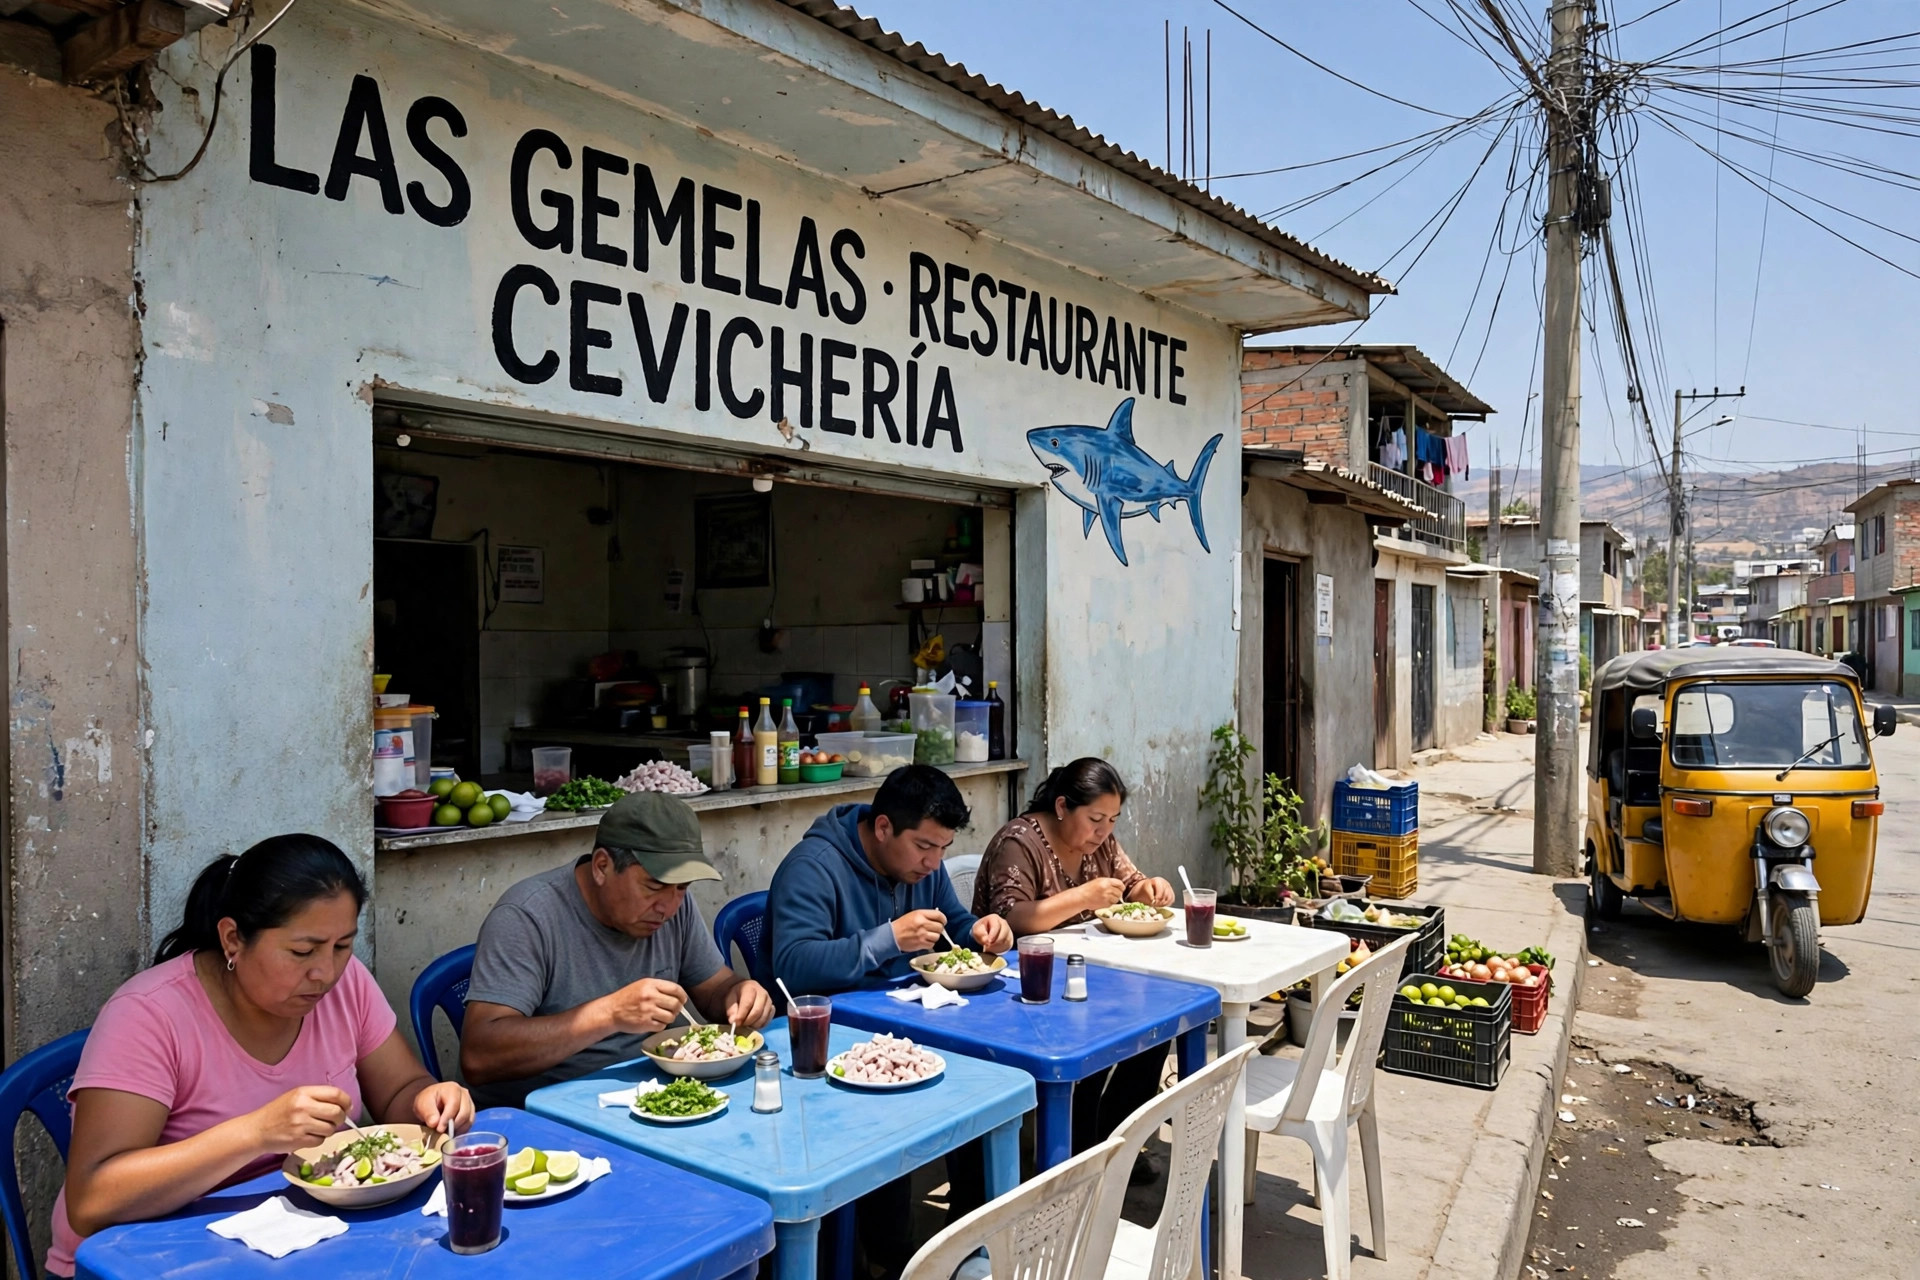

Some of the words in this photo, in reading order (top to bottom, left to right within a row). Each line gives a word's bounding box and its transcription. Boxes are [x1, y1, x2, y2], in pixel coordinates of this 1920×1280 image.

[249, 43, 472, 228] LAS
[511, 128, 867, 325] GEMELAS
[909, 251, 1188, 406] RESTAURANTE
[492, 263, 965, 454] CEVICHERÍA
